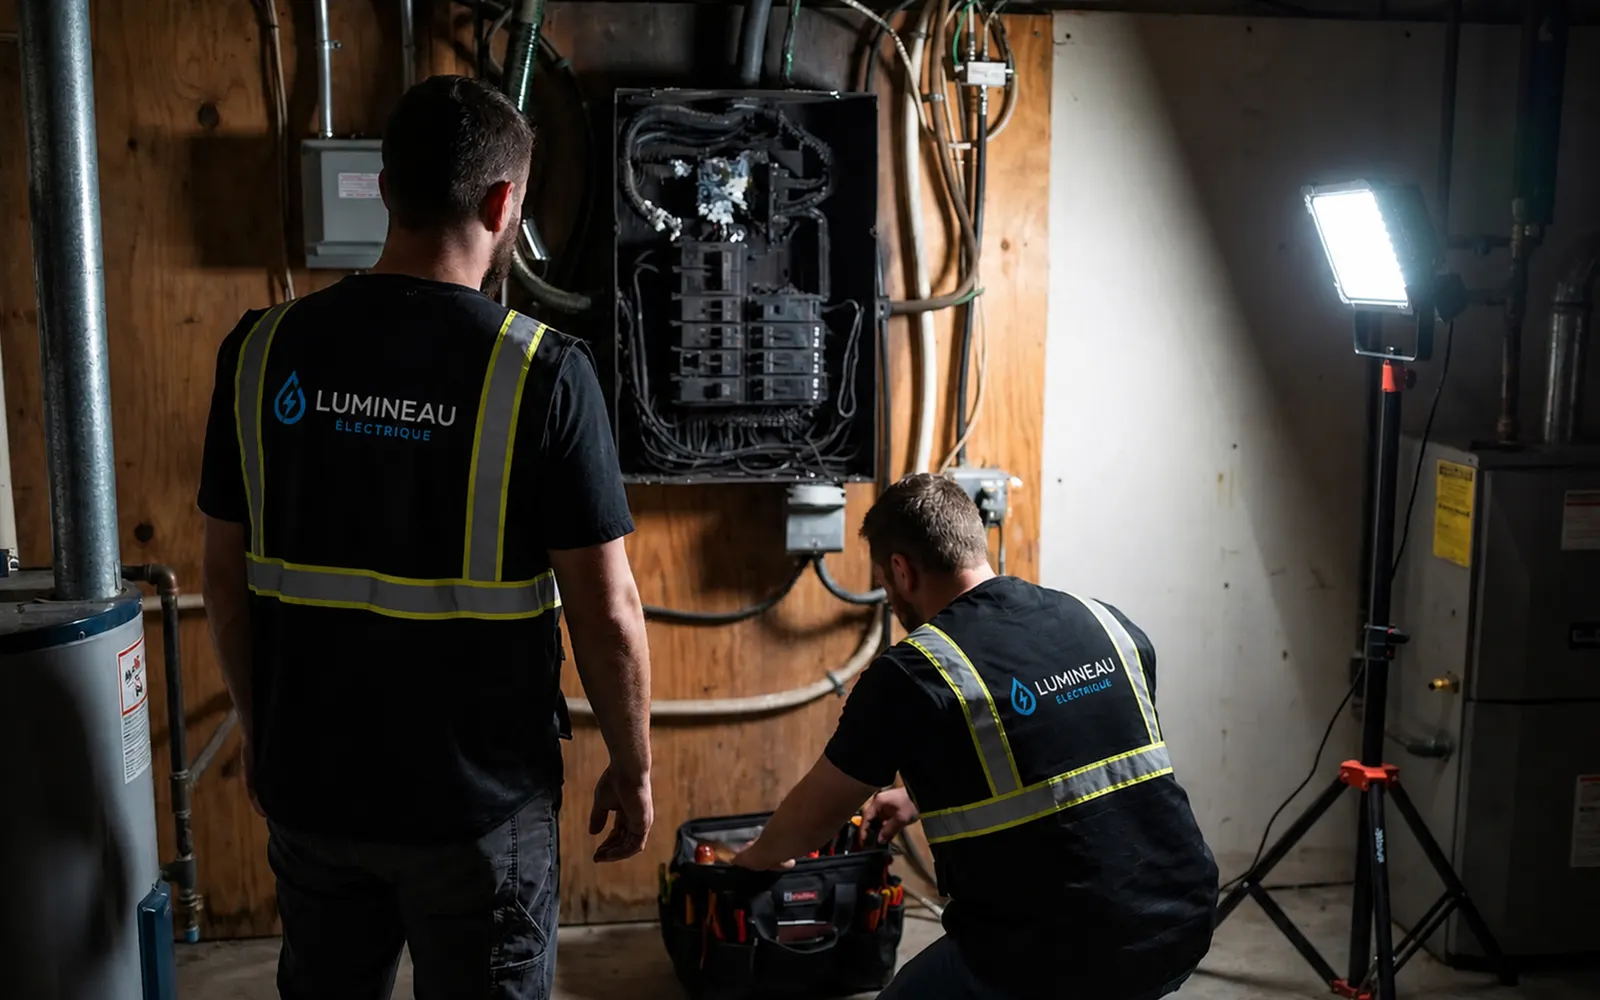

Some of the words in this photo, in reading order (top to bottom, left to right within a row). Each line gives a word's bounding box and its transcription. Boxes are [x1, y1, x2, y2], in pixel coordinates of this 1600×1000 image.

[316, 390, 456, 426] LUMINEAU
[335, 418, 431, 441] ÉLECTRIQUE
[1034, 657, 1116, 696] LUMINEAU
